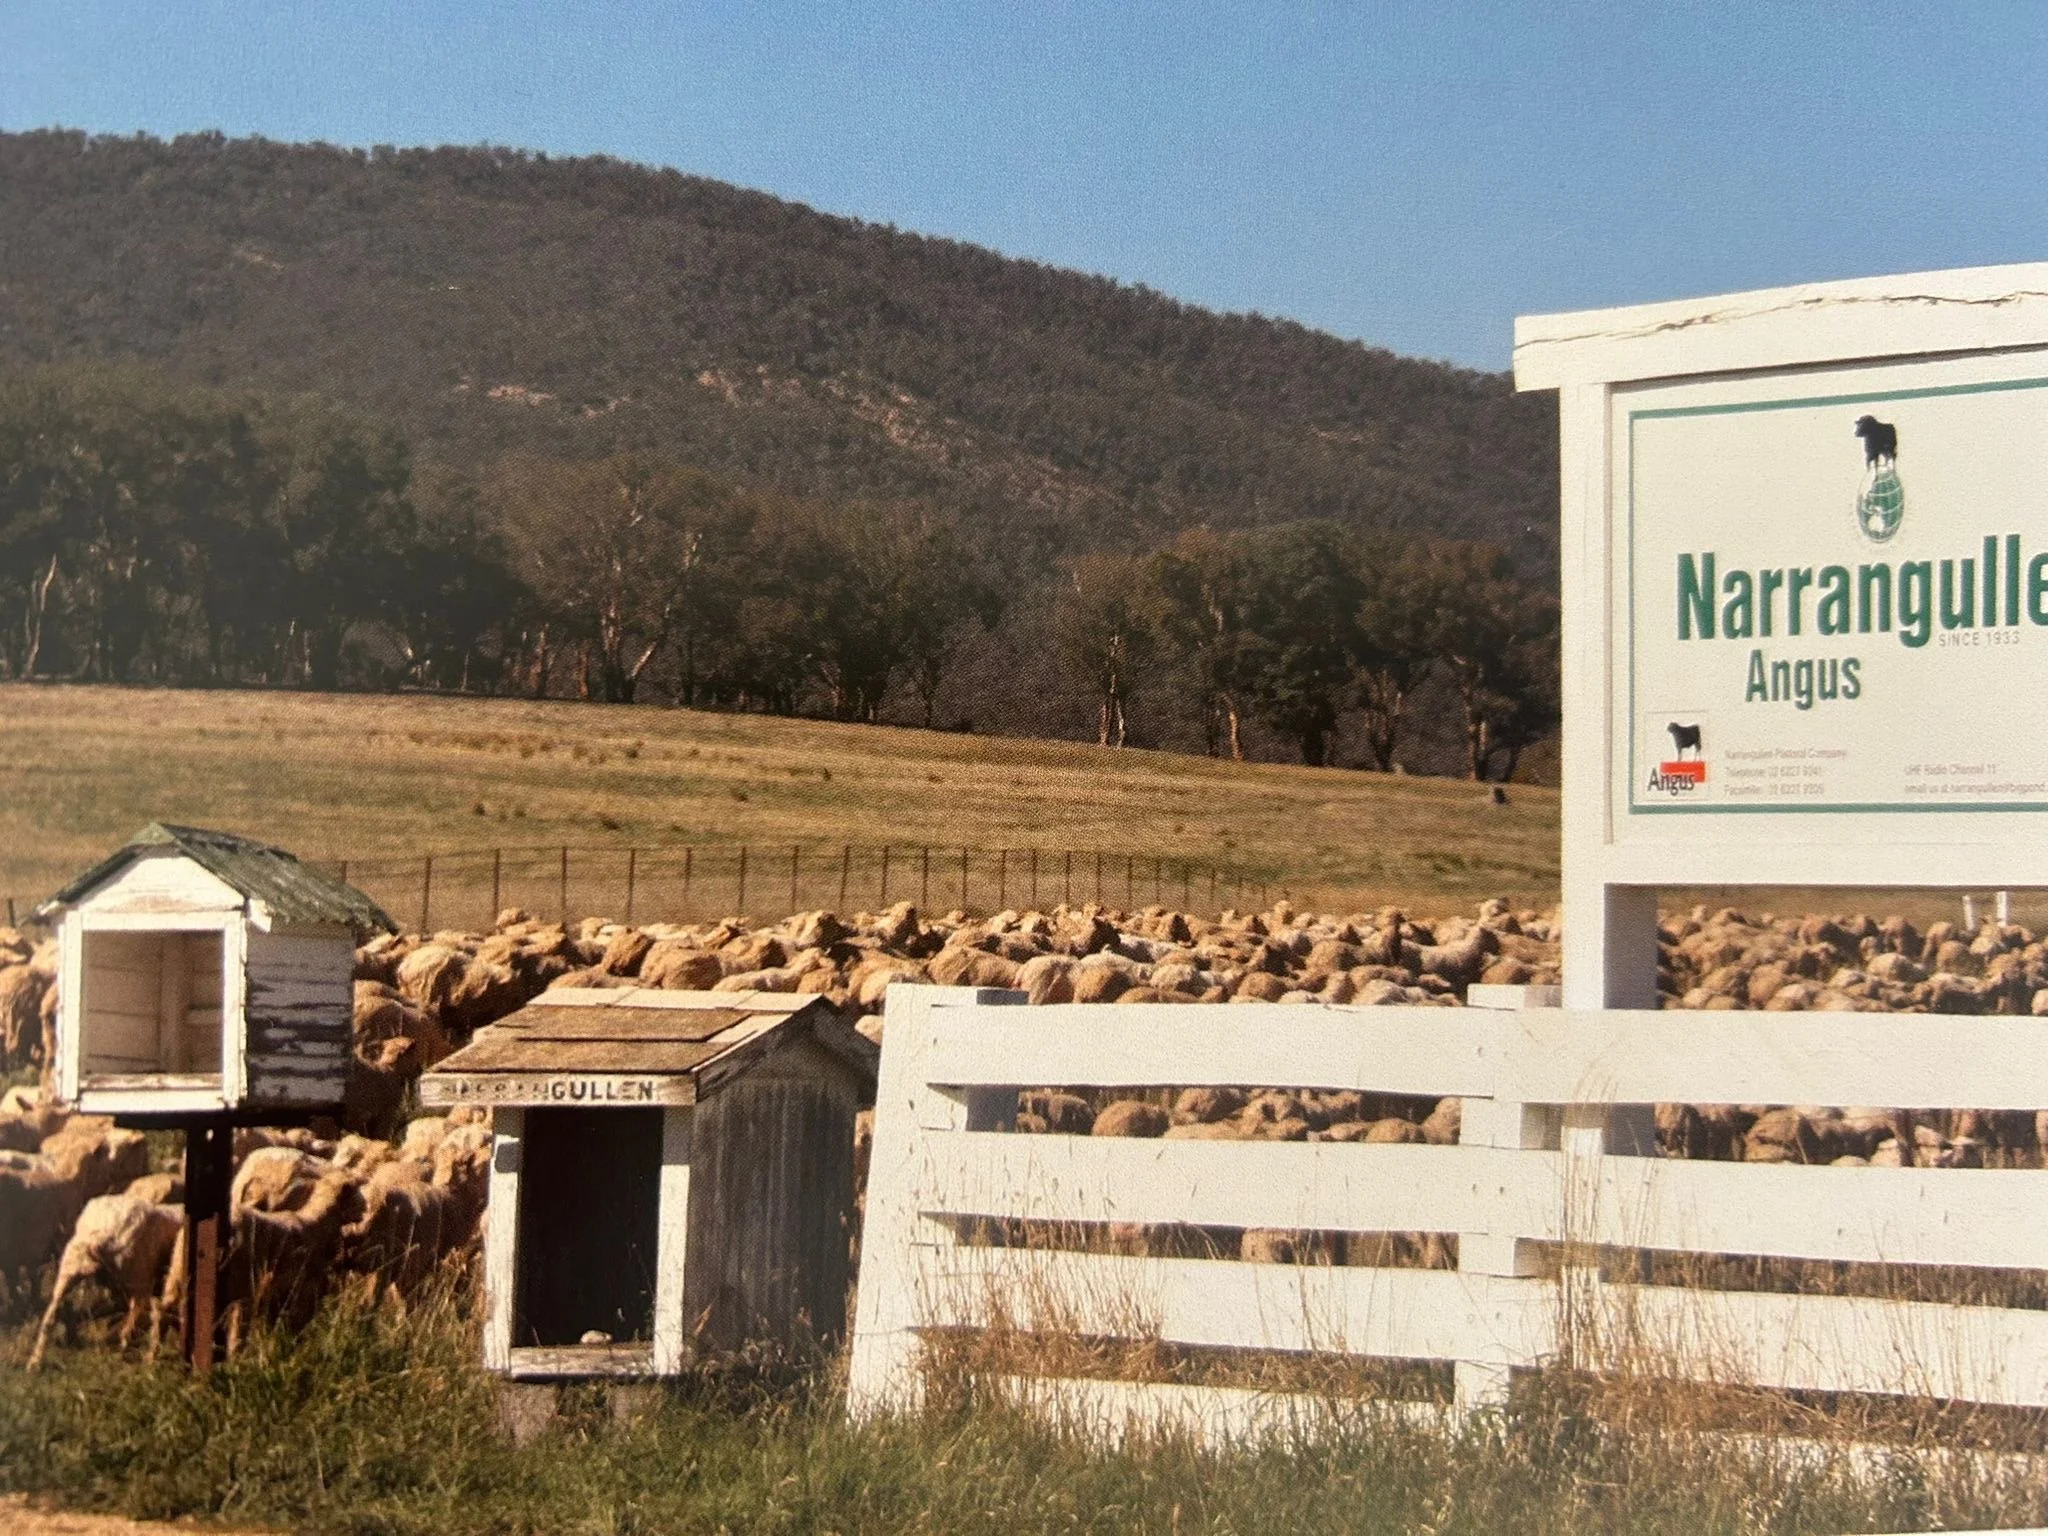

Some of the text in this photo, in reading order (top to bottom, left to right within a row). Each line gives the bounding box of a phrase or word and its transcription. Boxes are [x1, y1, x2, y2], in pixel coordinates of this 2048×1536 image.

[1677, 533, 2048, 648] Narrangulle
[1939, 631, 1979, 647] SINCE
[1745, 649, 1861, 710] Angus
[1647, 767, 1695, 796] Angus
[1949, 763, 1984, 775] Channel
